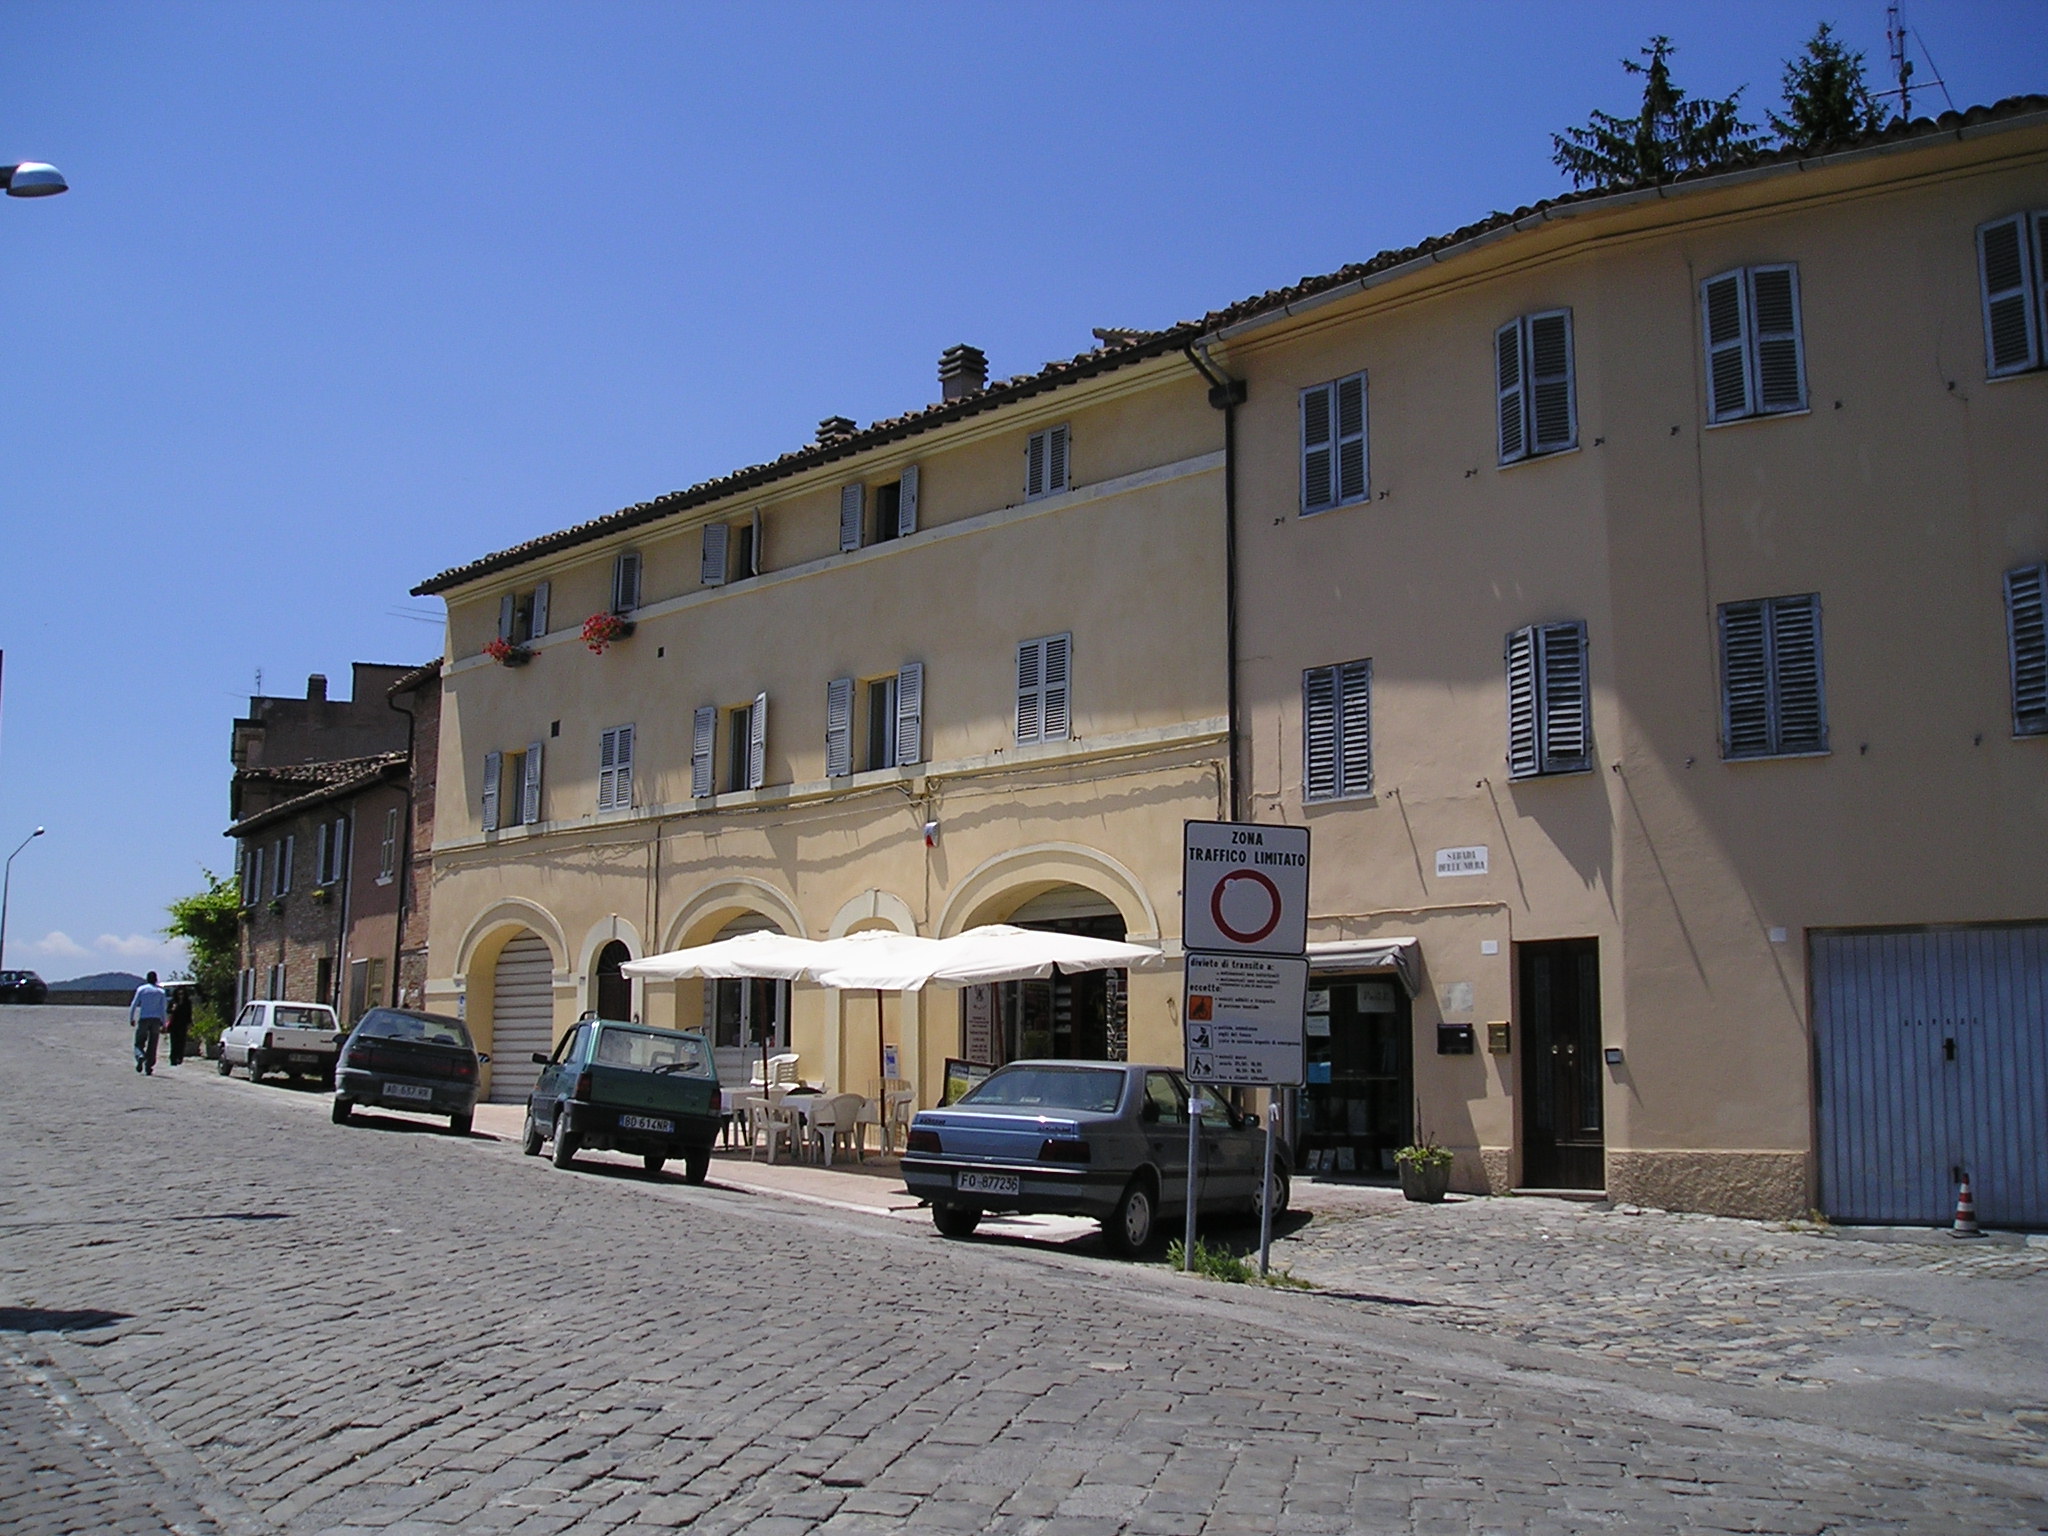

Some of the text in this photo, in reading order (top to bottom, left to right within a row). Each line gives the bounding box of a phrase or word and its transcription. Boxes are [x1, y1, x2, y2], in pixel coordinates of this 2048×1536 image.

[1231, 831, 1263, 846] ZONA
[1188, 847, 1306, 867] TRAFFICO LIMITATO
[1190, 957, 1219, 969] divieto
[1221, 958, 1229, 969] di
[1232, 960, 1264, 971] transito
